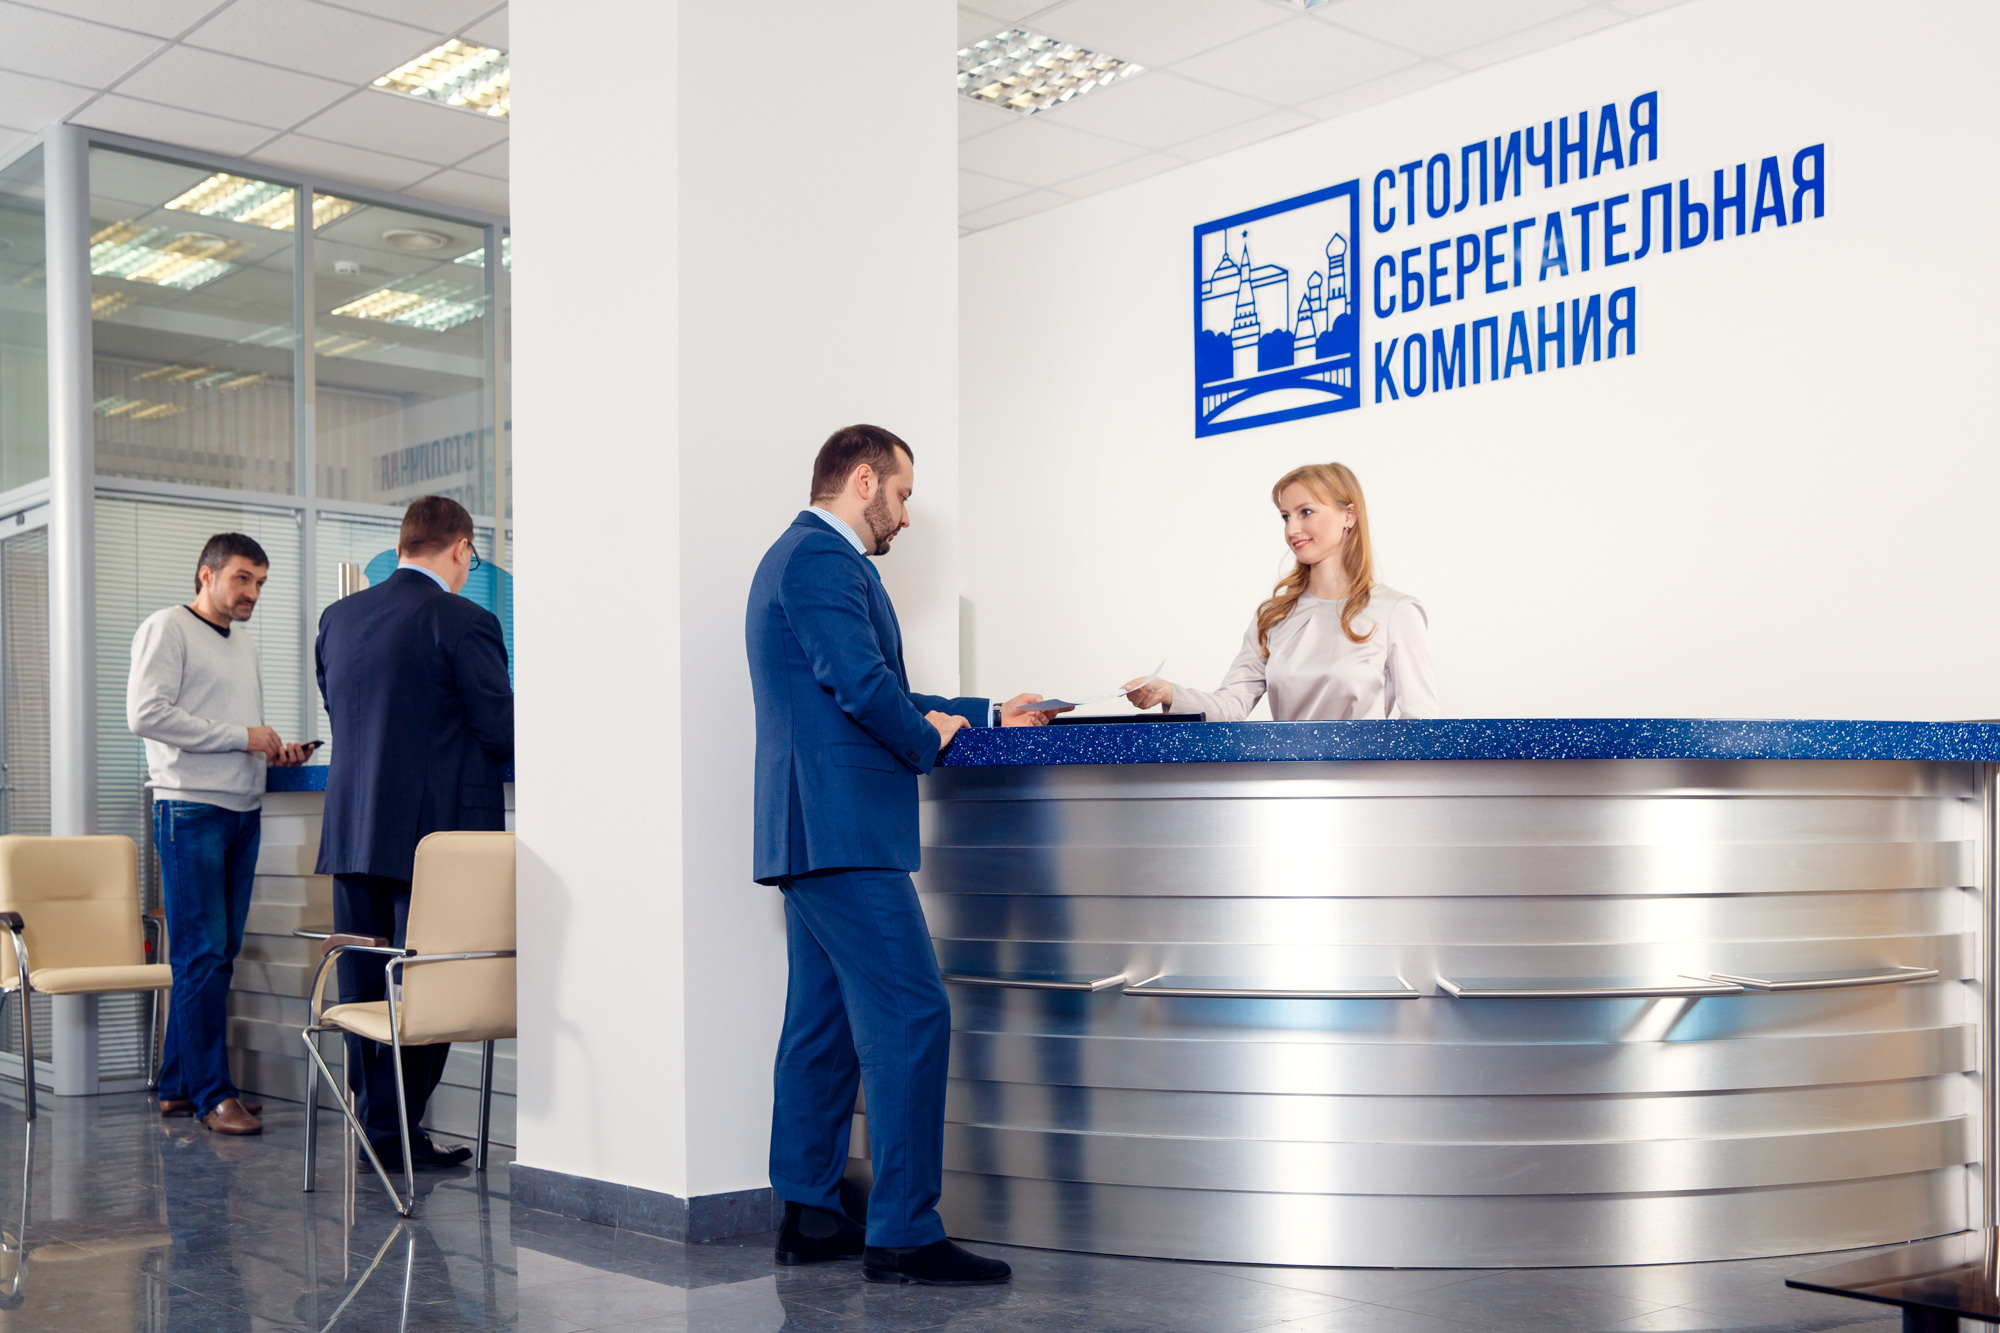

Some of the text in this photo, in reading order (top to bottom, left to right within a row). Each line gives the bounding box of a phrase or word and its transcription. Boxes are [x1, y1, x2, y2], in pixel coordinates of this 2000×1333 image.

[1373, 91, 1657, 233] СТОЛИЧНАЯ
[1373, 143, 1824, 319] СБЕРЕГАТЕЛЬНАЯ
[1375, 286, 1635, 403] КОМПАНИЯ
